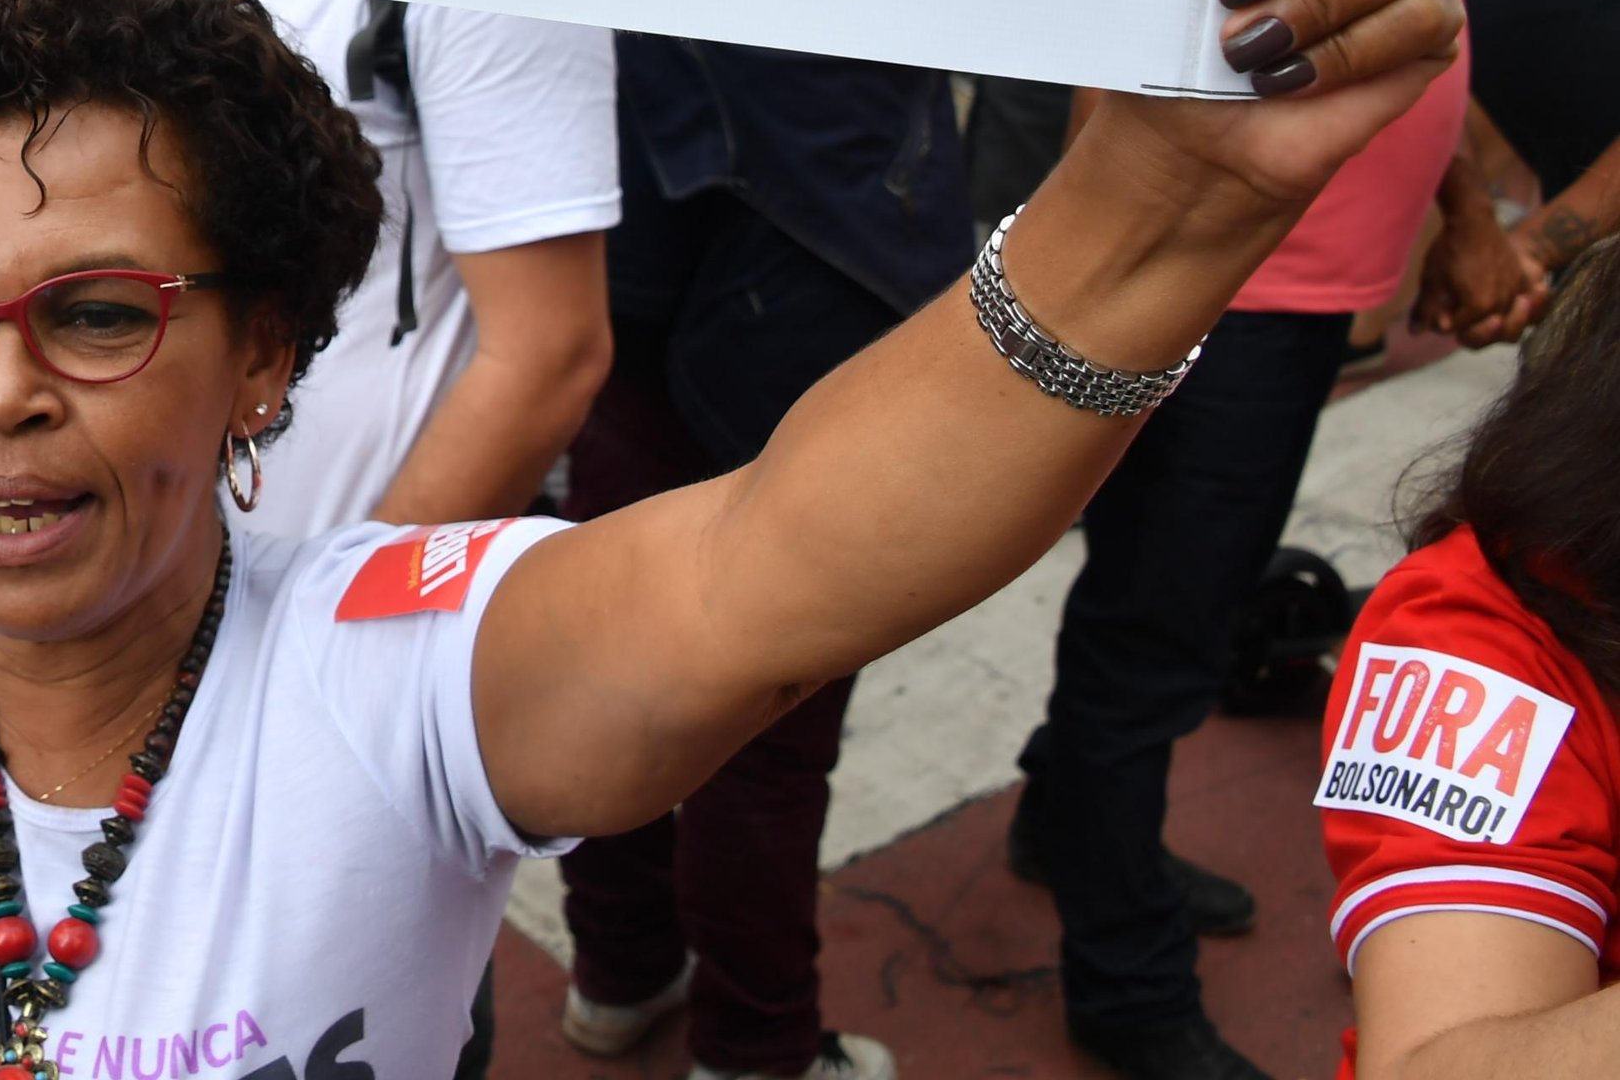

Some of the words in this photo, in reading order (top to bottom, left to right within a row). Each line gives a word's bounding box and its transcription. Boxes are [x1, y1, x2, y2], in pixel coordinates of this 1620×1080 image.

[1341, 658, 1538, 798] FORA
[1323, 761, 1507, 844] BOLSONARO!
[92, 1008, 268, 1080] NUNCA
